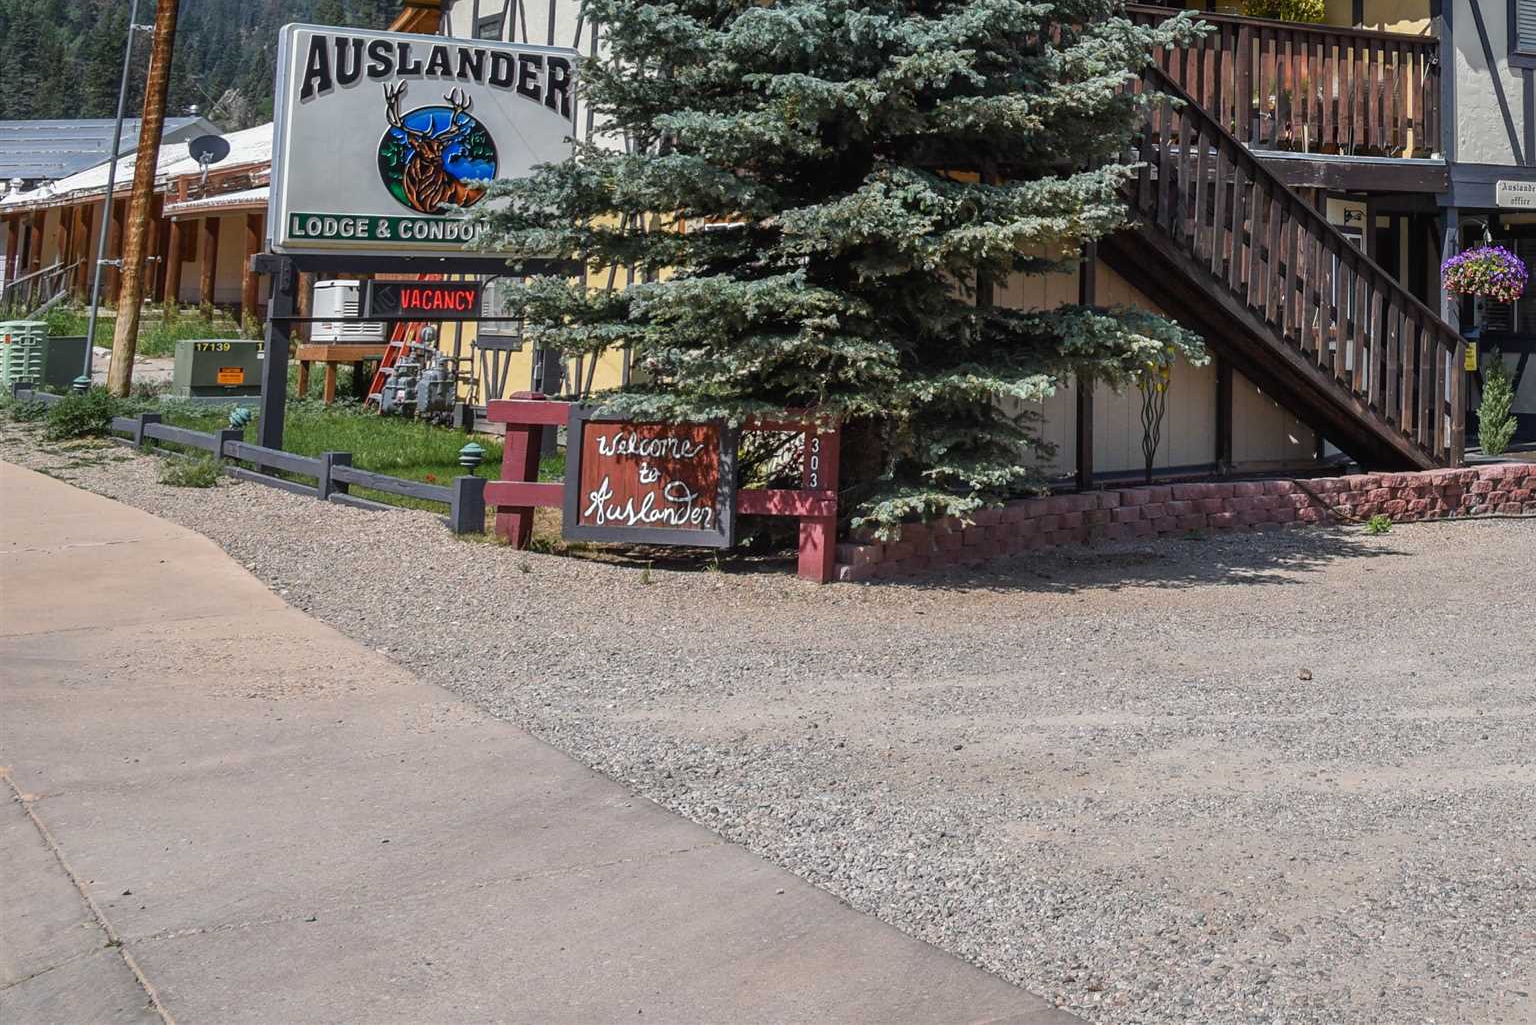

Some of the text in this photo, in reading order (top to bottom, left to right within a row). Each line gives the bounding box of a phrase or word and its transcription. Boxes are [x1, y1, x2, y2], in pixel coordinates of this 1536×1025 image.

[299, 35, 572, 120] AUSLANDER
[292, 216, 369, 238] LODGE
[375, 219, 391, 238] &
[401, 289, 474, 310] VACANCY
[195, 343, 230, 352] 17139
[597, 432, 704, 458] Welcome
[639, 462, 661, 483] to
